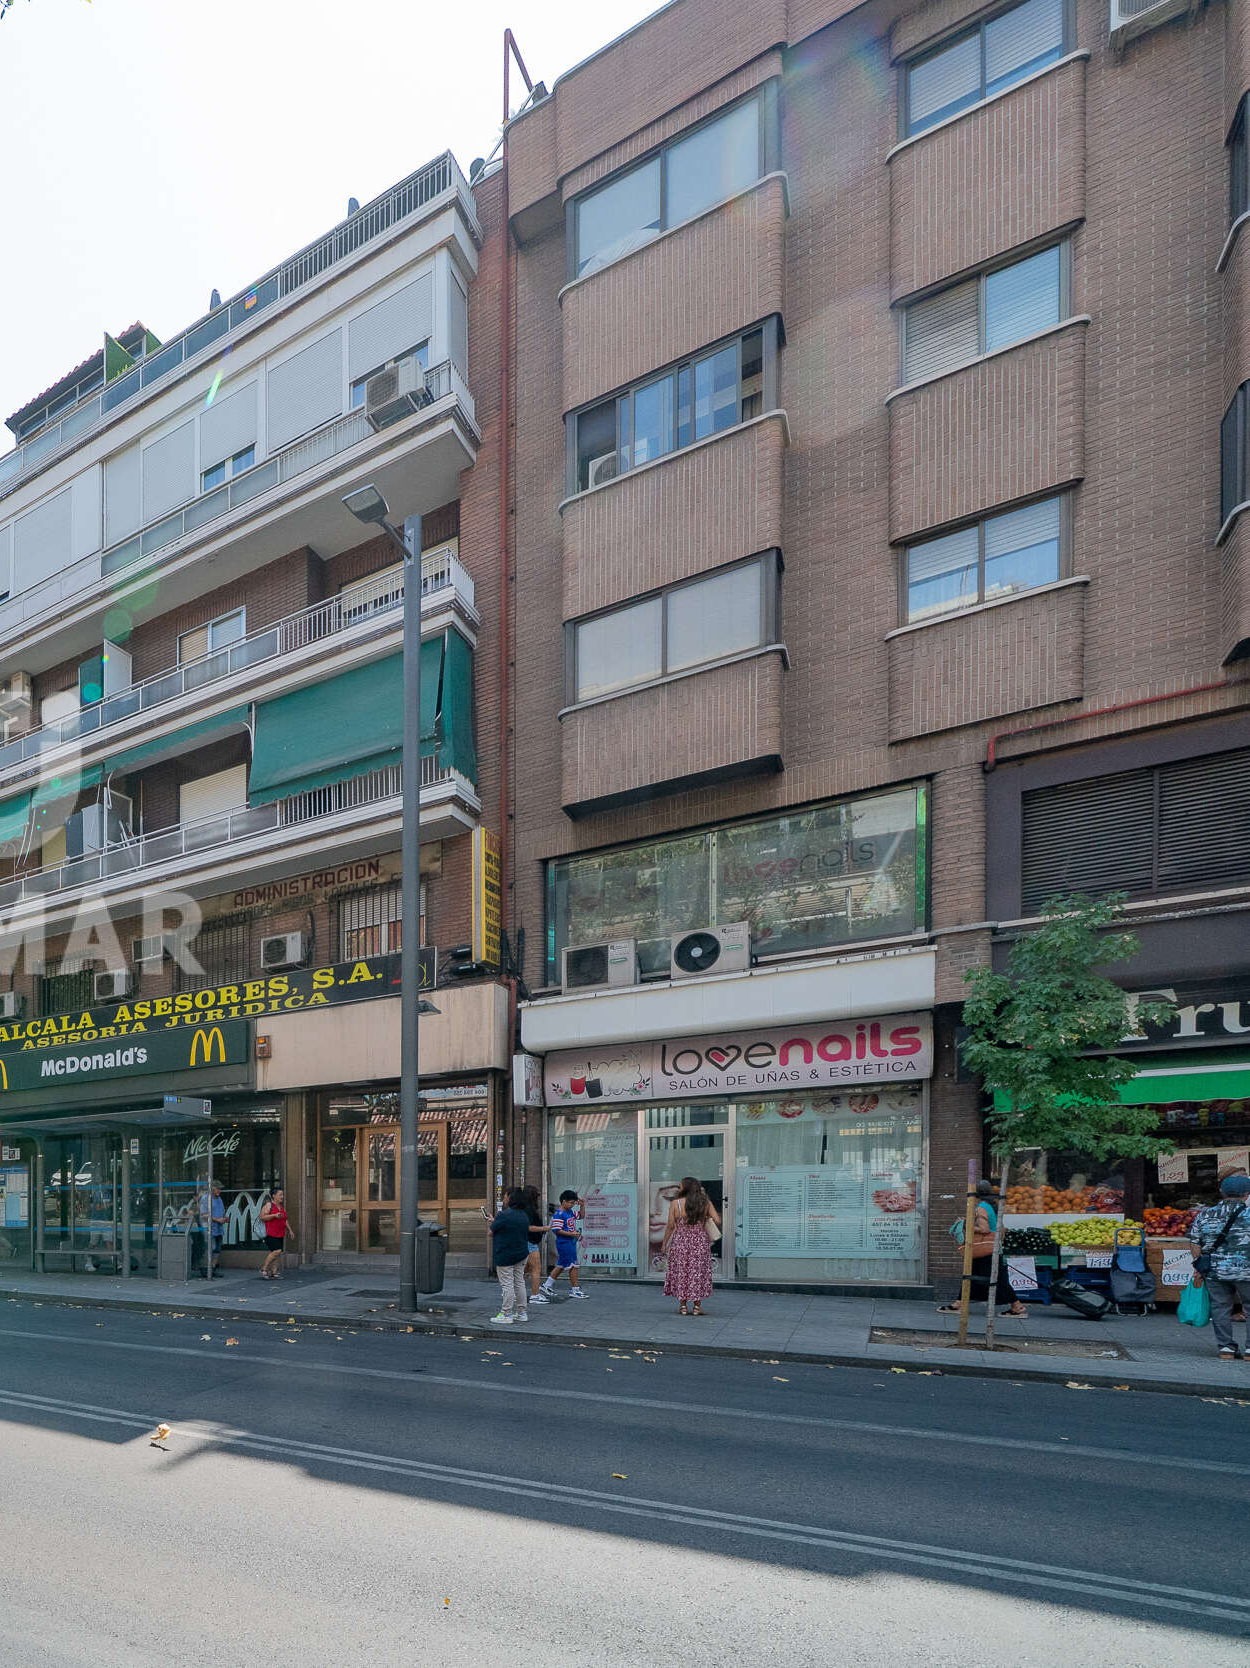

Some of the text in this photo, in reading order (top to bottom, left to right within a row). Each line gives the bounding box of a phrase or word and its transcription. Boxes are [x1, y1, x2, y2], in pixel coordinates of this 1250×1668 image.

[234, 859, 380, 908] ADMINISTRACION
[113, 976, 297, 1023] ASESORES,
[312, 962, 383, 990] S.A.
[21, 992, 329, 1050] ASESORIA JURIDICA
[41, 1047, 148, 1077] McDonald's
[669, 1060, 917, 1091] SALÓN DE UÑAS & ESTÉTICA
